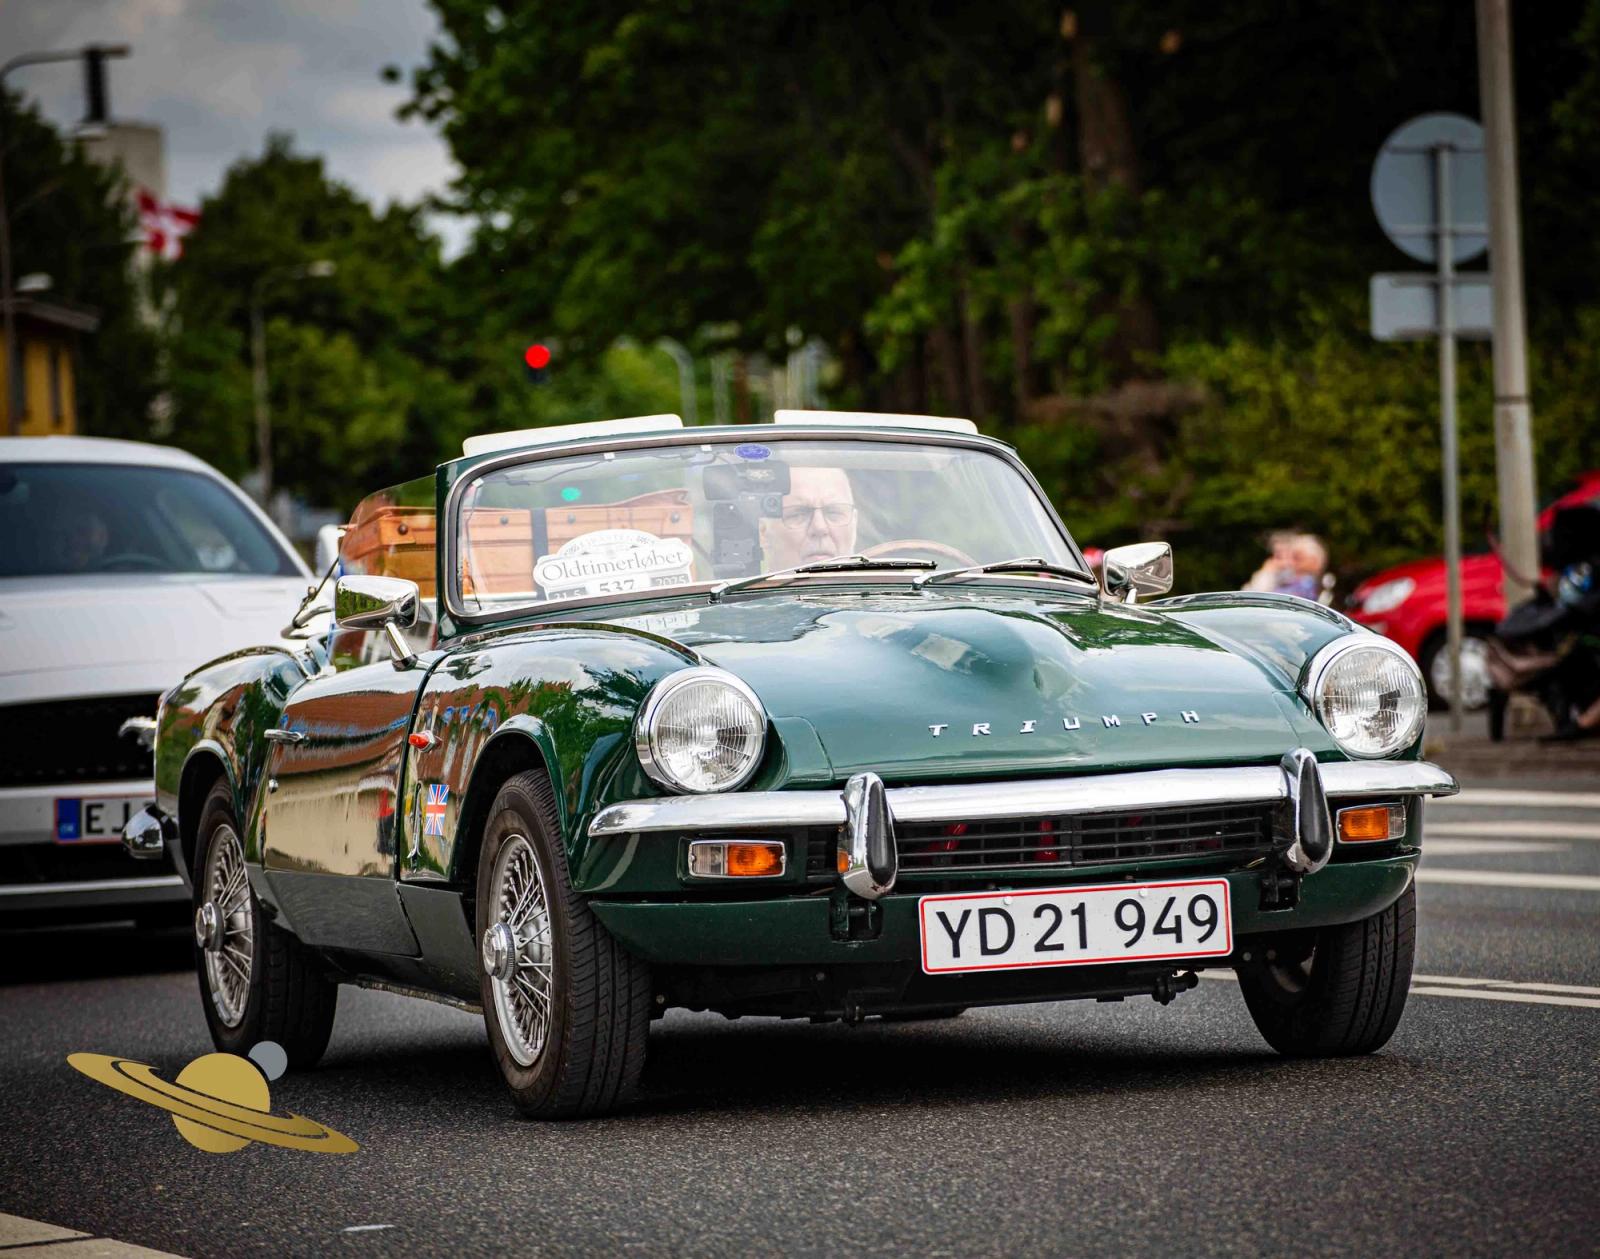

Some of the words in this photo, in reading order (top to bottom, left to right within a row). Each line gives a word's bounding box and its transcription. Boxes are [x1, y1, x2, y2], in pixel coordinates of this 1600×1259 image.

[599, 579, 635, 593] 537
[928, 710, 1200, 737] TRIUMPH
[936, 907, 1016, 959] YD
[1033, 902, 1088, 953] 21
[1114, 893, 1219, 949] 949
